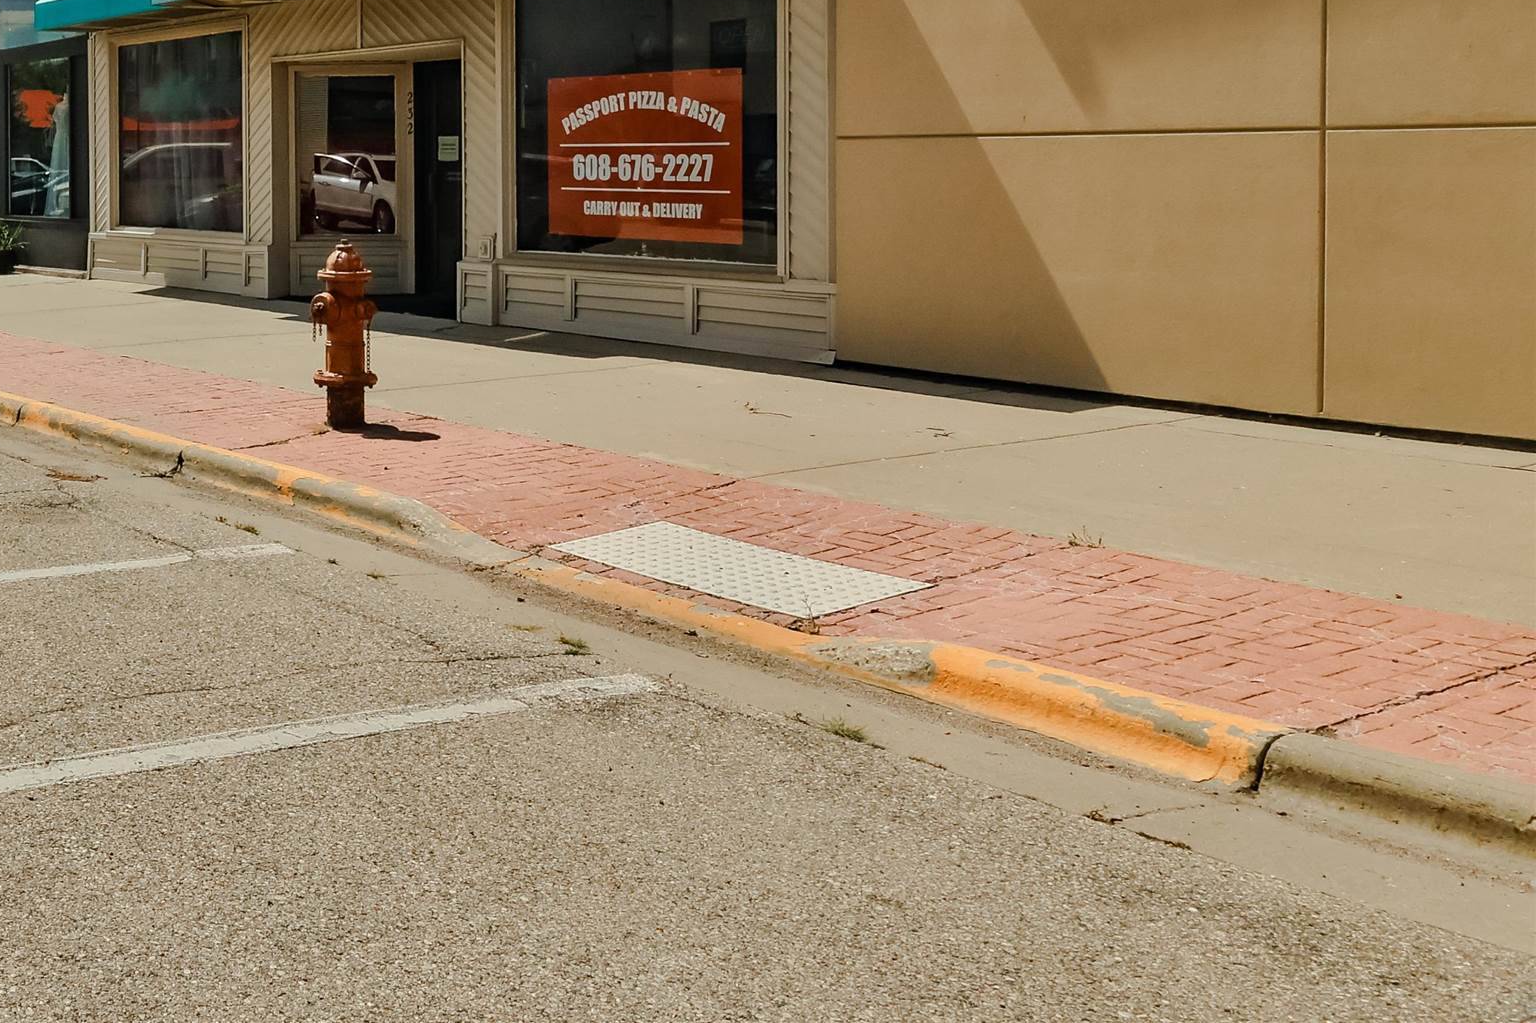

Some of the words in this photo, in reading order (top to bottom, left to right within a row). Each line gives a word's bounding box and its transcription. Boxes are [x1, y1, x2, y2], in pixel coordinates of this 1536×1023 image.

[561, 92, 625, 135] PASSPORT
[628, 91, 665, 111] PIZZA
[667, 96, 678, 113] &
[680, 97, 726, 133] PASTA
[573, 153, 714, 182] 608-676-2227
[583, 200, 618, 216] CARRY
[619, 201, 641, 217] OUT
[642, 204, 652, 218] &
[652, 202, 704, 220] DELIVERY
